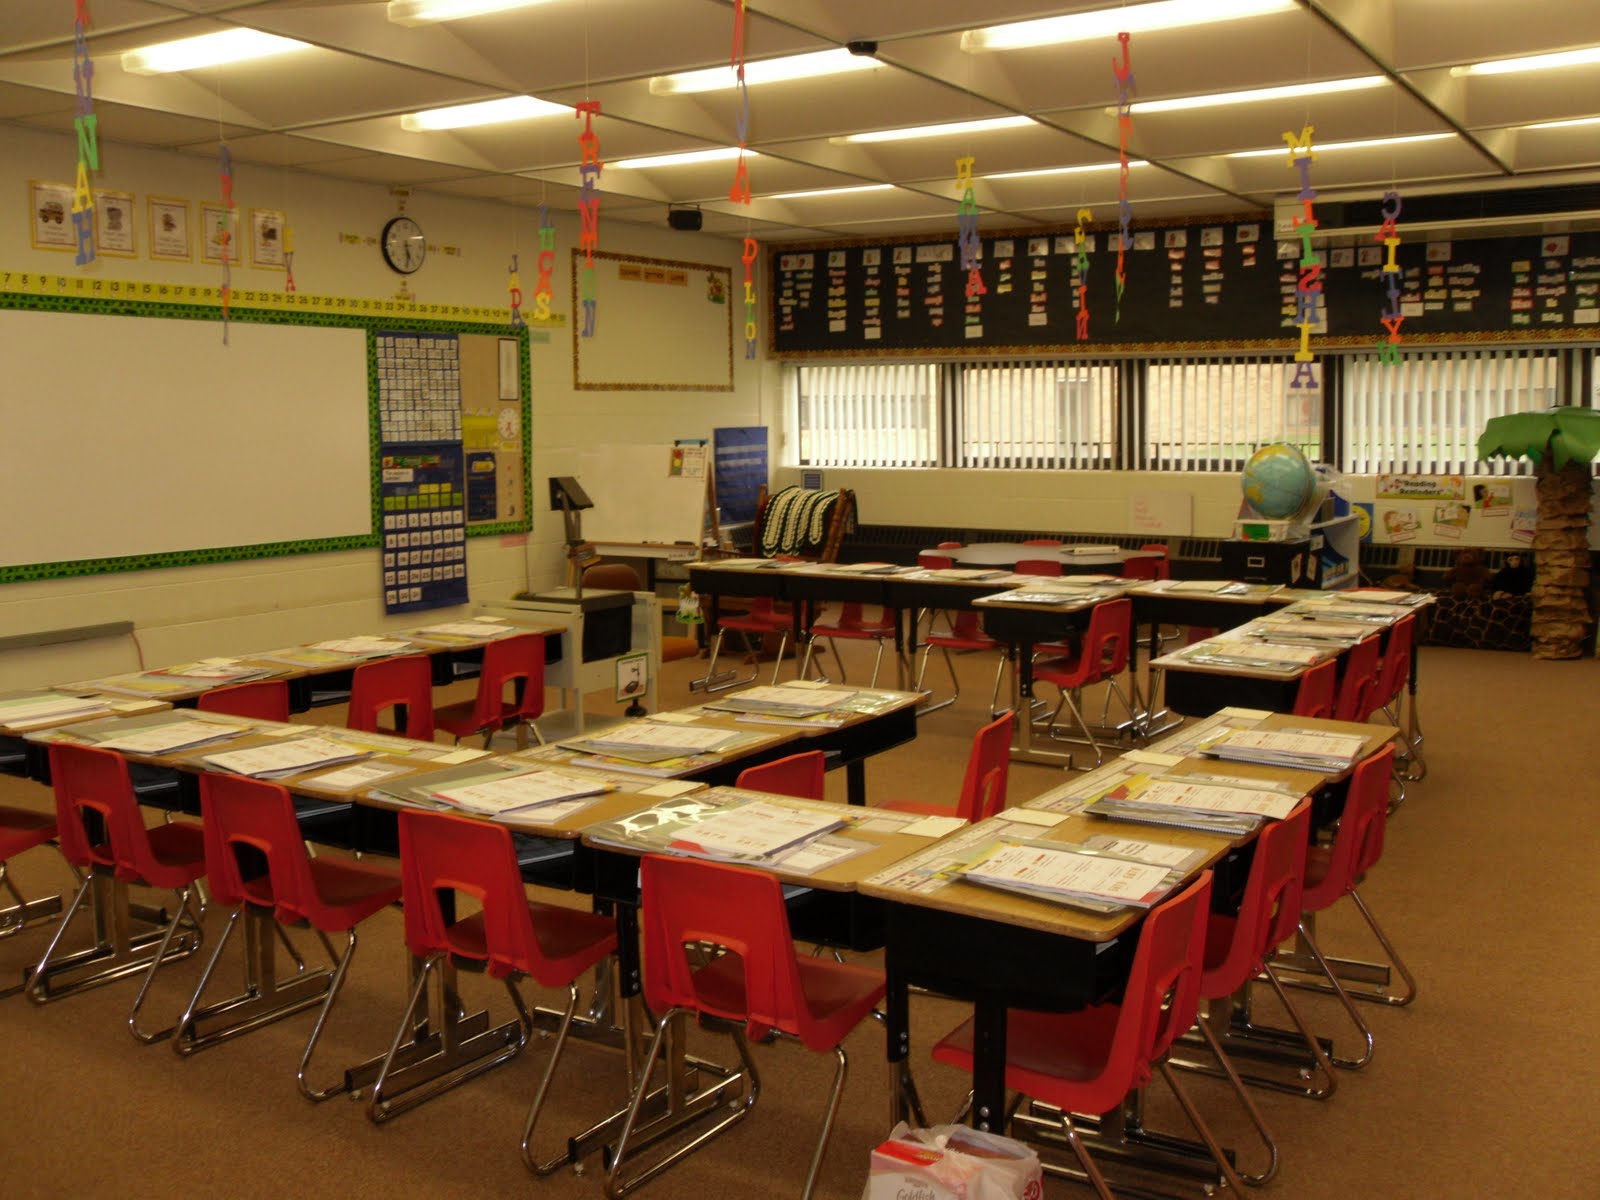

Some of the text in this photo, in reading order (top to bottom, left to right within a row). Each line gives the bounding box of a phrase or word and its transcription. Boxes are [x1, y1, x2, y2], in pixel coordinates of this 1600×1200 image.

[4, 273, 11, 282] 7
[22, 275, 28, 284] 8
[40, 276, 46, 285] 9
[57, 278, 66, 287] 10
[76, 280, 83, 288] 11
[93, 281, 102, 290] 12
[110, 282, 119, 291] 13
[127, 283, 135, 292] 14
[143, 284, 151, 293] 15
[159, 285, 168, 294] 16
[174, 286, 182, 295] 17
[189, 288, 196, 296] 18
[232, 291, 240, 299] 21
[245, 292, 254, 301] 22
[259, 293, 269, 301] 23
[272, 294, 281, 302] 24
[286, 295, 295, 303] 25
[299, 296, 308, 304] 26
[312, 297, 321, 305] 27
[324, 297, 333, 305] 28
[337, 298, 345, 306] 29
[896, 1188, 935, 1200] Goldfish
